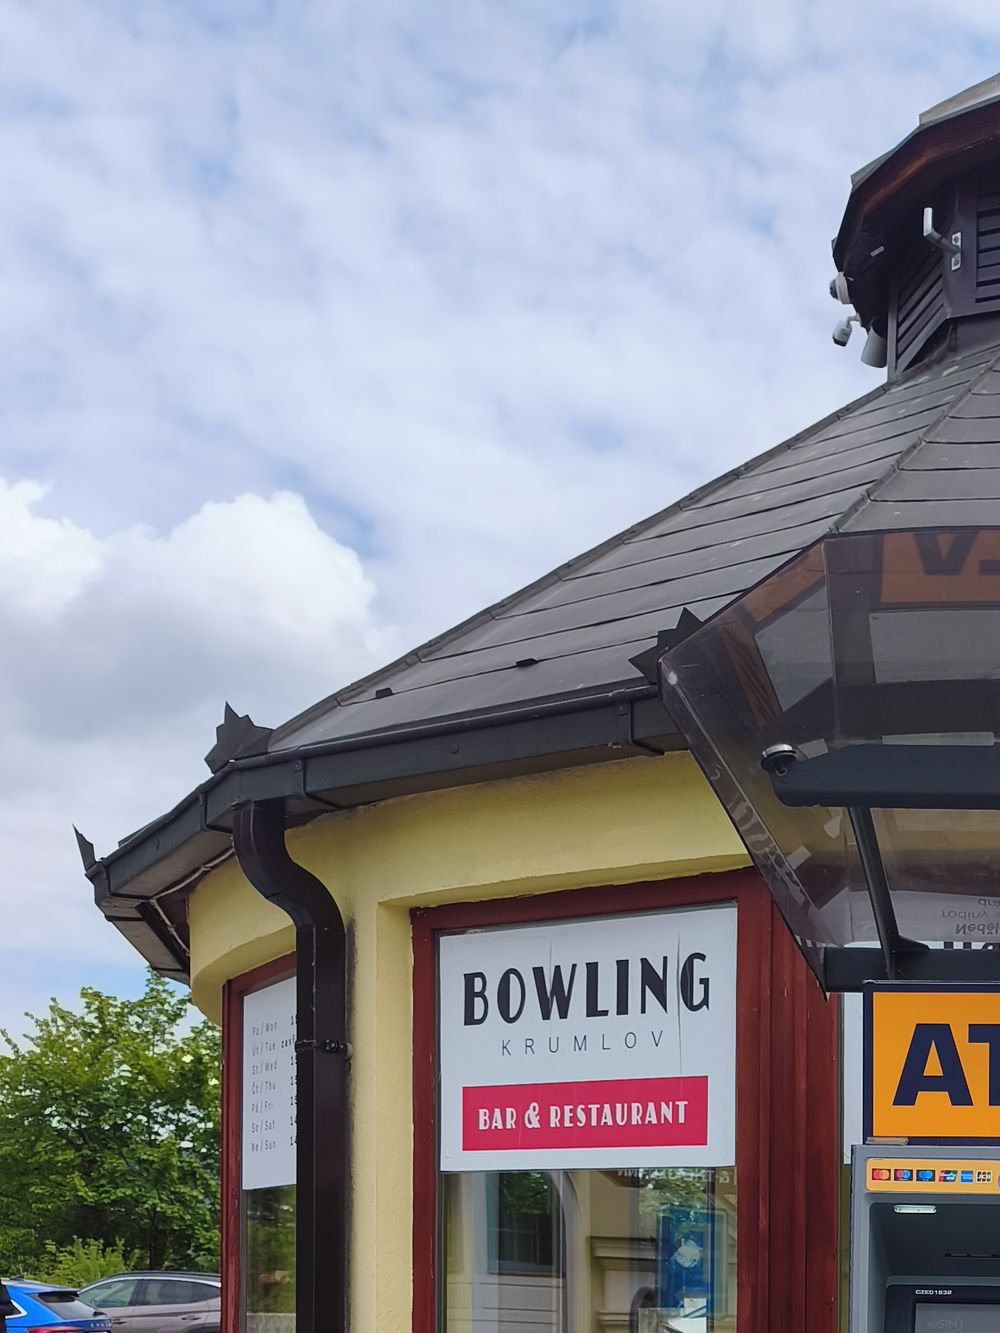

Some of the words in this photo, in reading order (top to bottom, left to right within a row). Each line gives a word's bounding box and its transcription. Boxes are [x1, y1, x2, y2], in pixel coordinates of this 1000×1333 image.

[463, 952, 710, 1026] BOWLING
[502, 1030, 663, 1056] KRUMLOV
[478, 1107, 517, 1130] BAR
[524, 1101, 541, 1129] &
[549, 1101, 689, 1128] RESTAURANT
